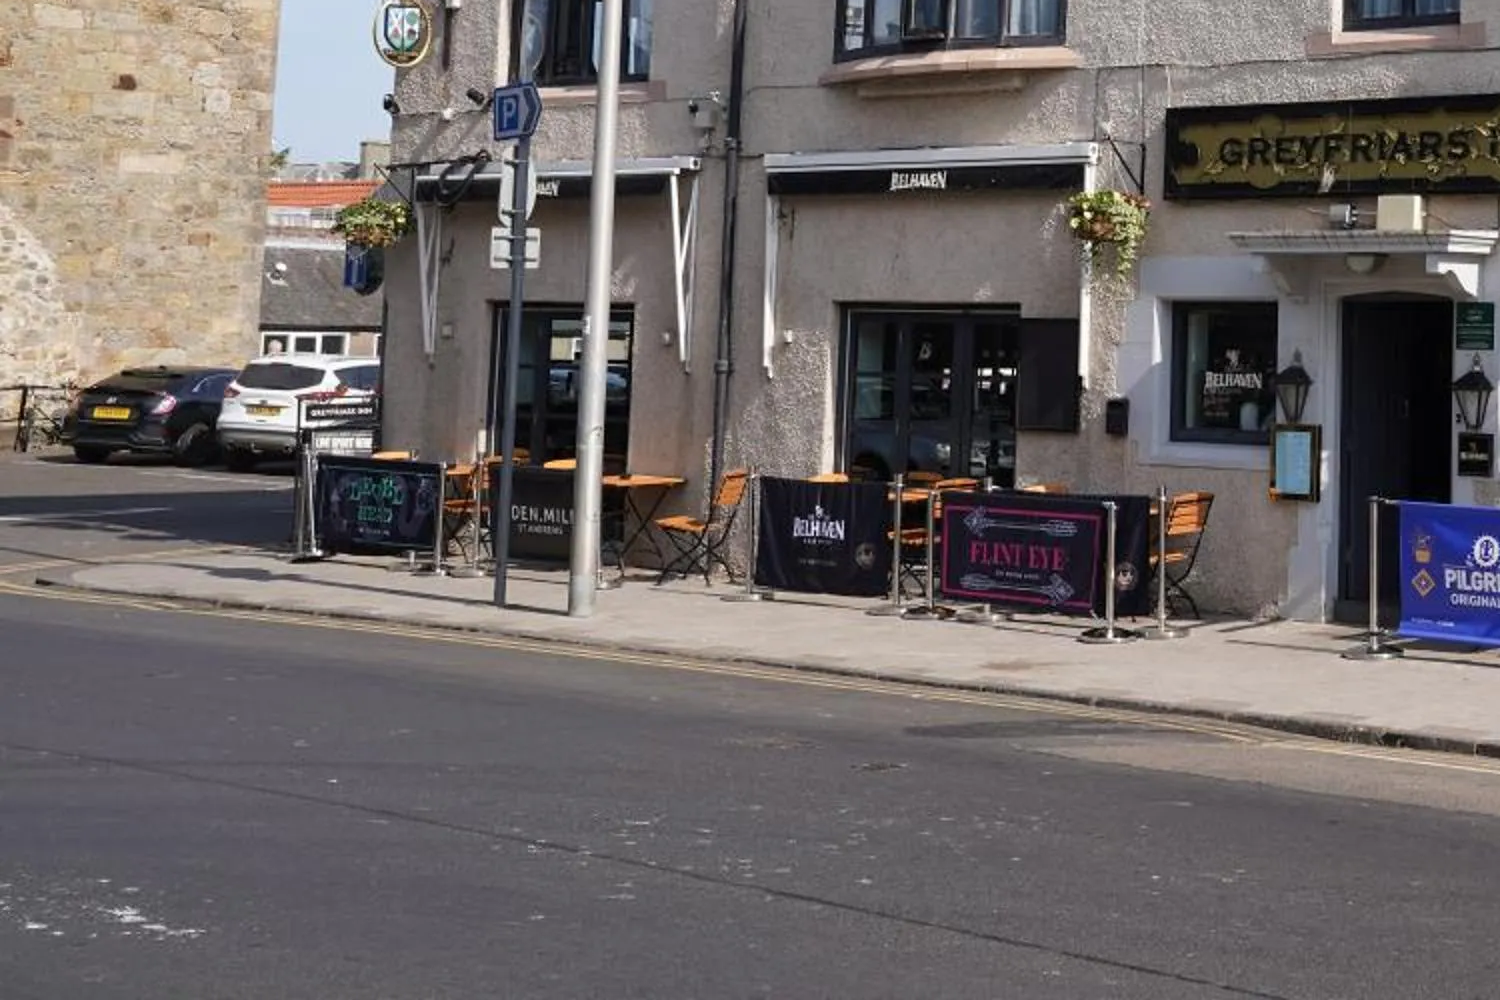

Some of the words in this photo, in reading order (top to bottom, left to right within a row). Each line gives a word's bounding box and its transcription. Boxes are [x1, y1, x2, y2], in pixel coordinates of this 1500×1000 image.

[502, 98, 517, 129] P
[1219, 130, 1472, 167] GREYFRIARS
[889, 170, 948, 191] BELHAVEN
[1205, 371, 1263, 389] BELHAVEN
[793, 516, 846, 540] BELHAVEN
[969, 540, 1024, 568] FLINT
[1027, 545, 1066, 571] EYE
